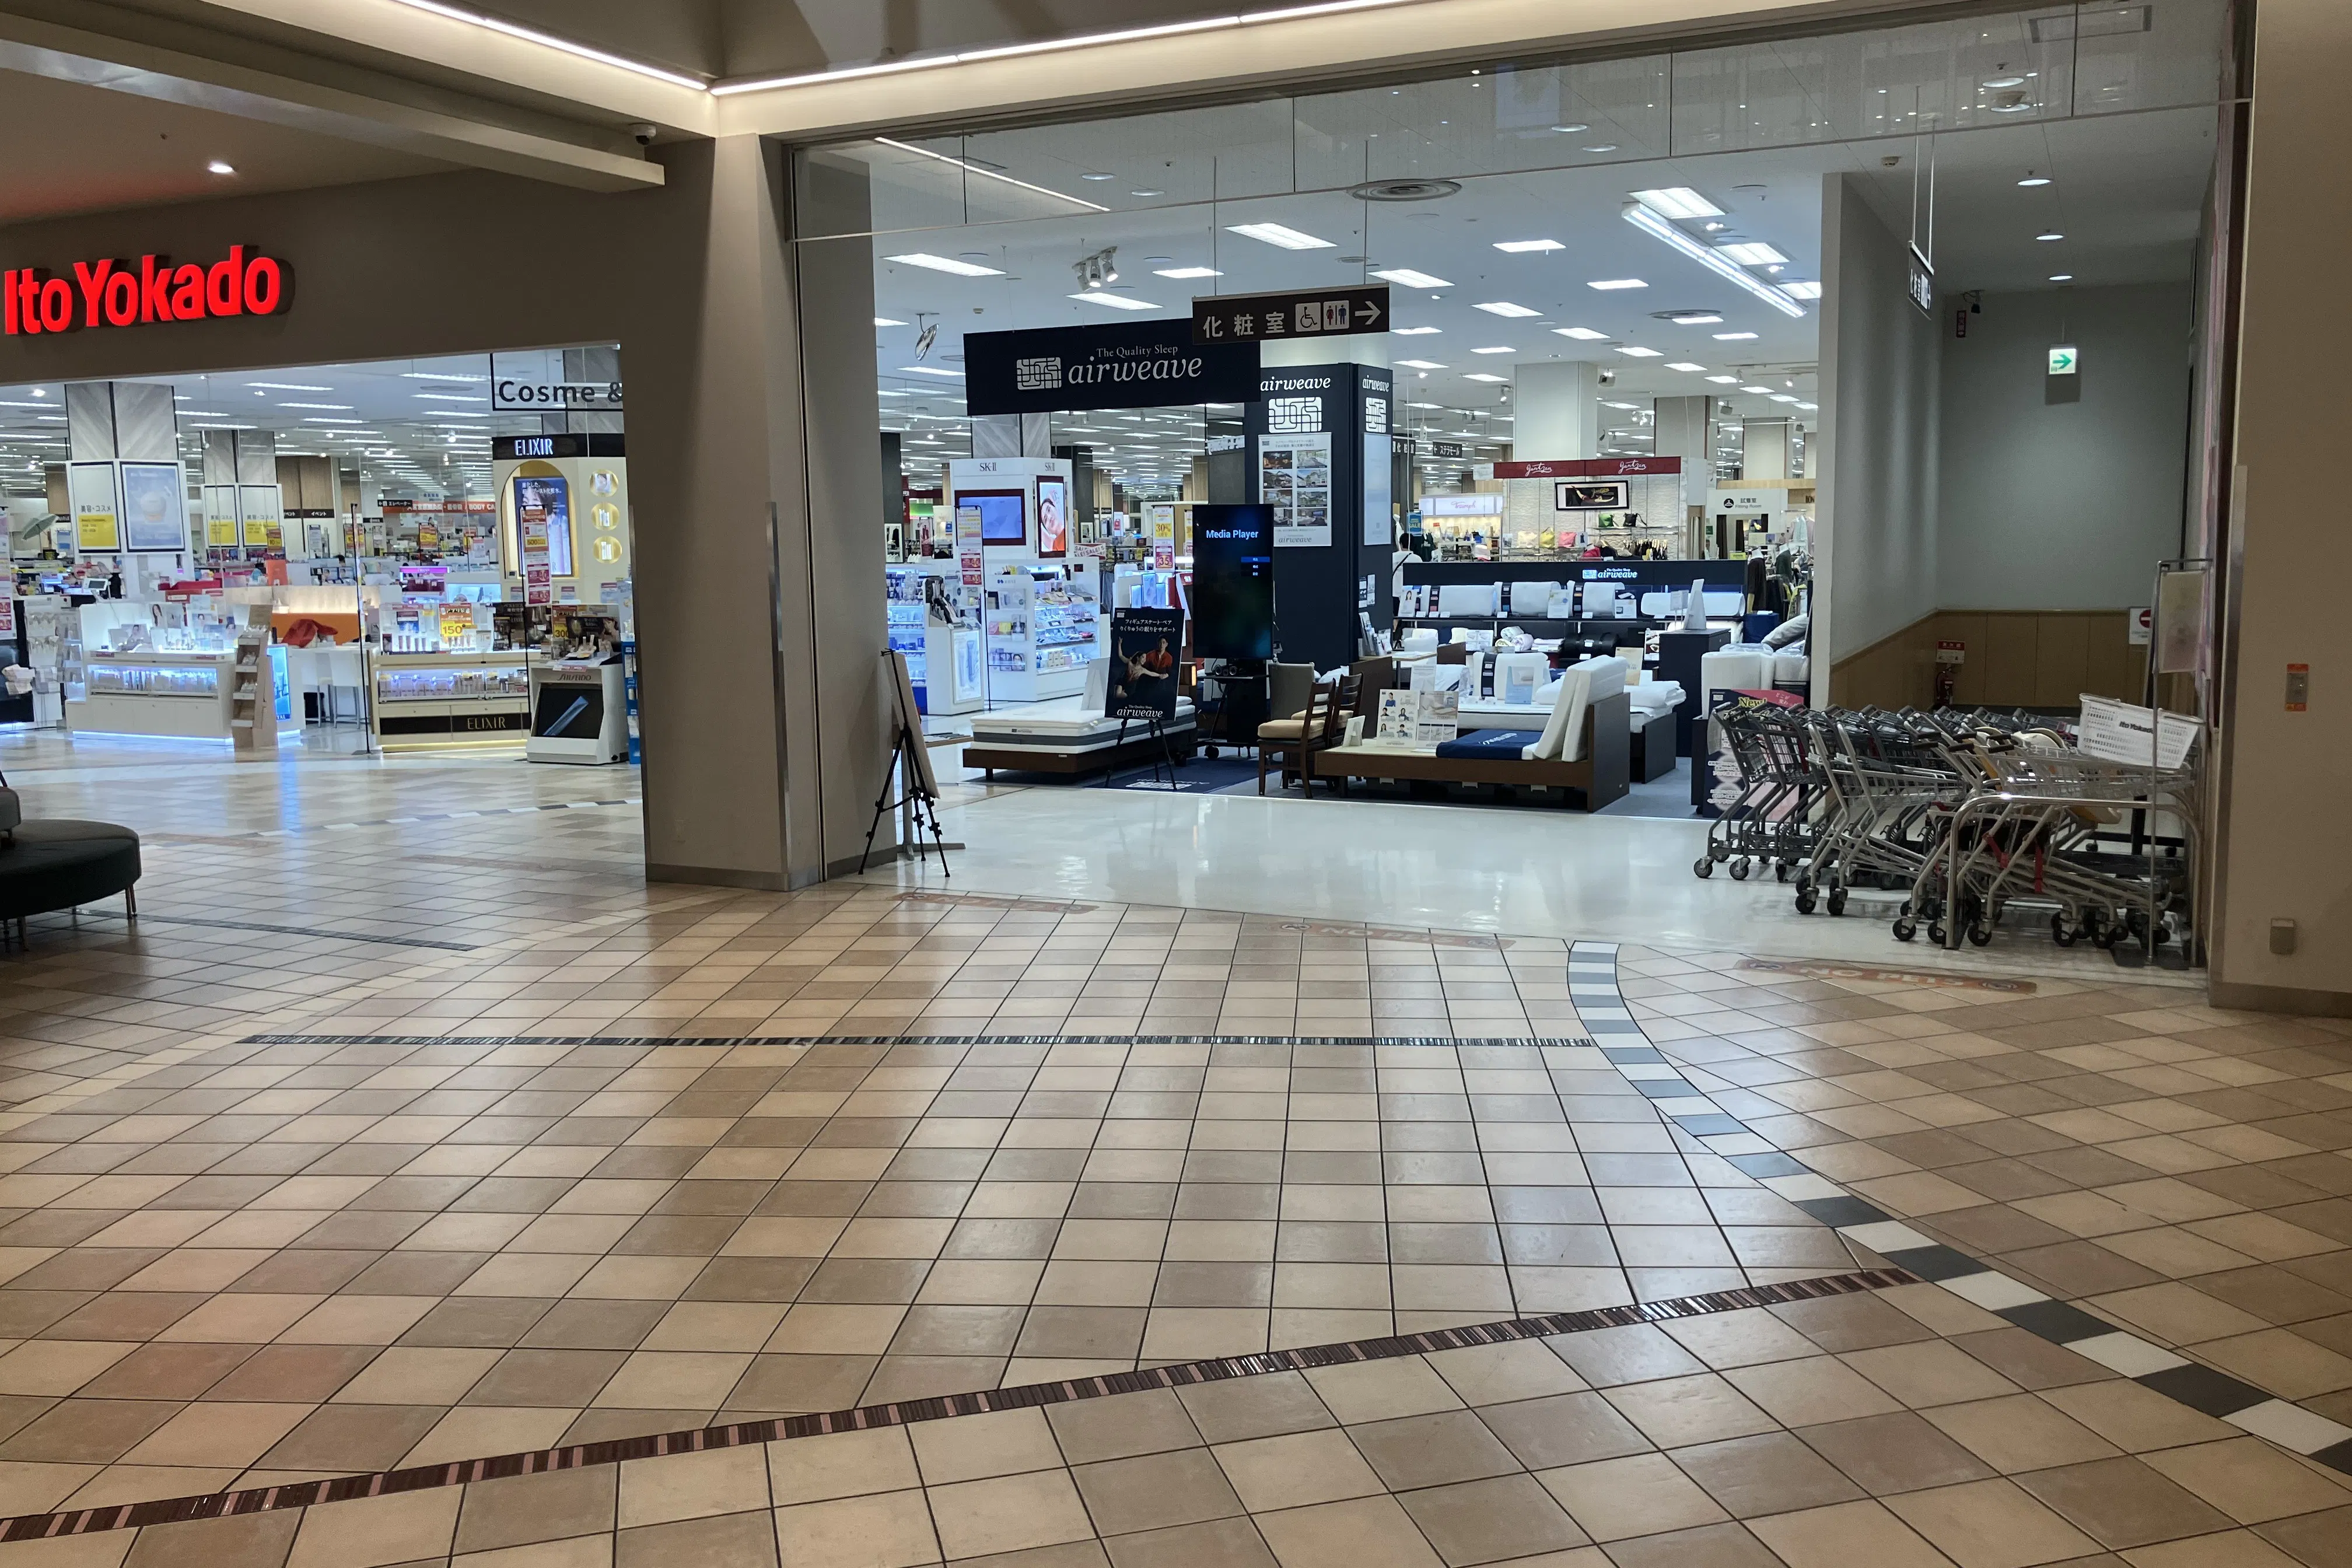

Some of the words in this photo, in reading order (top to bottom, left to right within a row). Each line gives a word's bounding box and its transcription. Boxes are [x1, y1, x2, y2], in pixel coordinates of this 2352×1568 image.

[4, 268, 72, 335] Ito
[73, 244, 281, 327] Yokado
[1203, 312, 1285, 338] 化粧室
[1096, 348, 1114, 358] The
[1116, 346, 1152, 358] Quality
[1154, 344, 1178, 356] Sleep
[1068, 356, 1202, 384] airweave
[1260, 376, 1331, 391] airweave
[1362, 374, 1390, 392] airweave
[499, 381, 596, 402] Cosme
[607, 382, 623, 402] &
[514, 438, 554, 456] ELIXIR
[1206, 530, 1231, 538] Media
[1233, 530, 1259, 540] Player
[1598, 569, 1637, 578] airweave
[443, 625, 463, 635] 150
[1116, 706, 1163, 718] airweave
[467, 716, 506, 730] ELIXIR
[2130, 723, 2154, 734] Yokad
